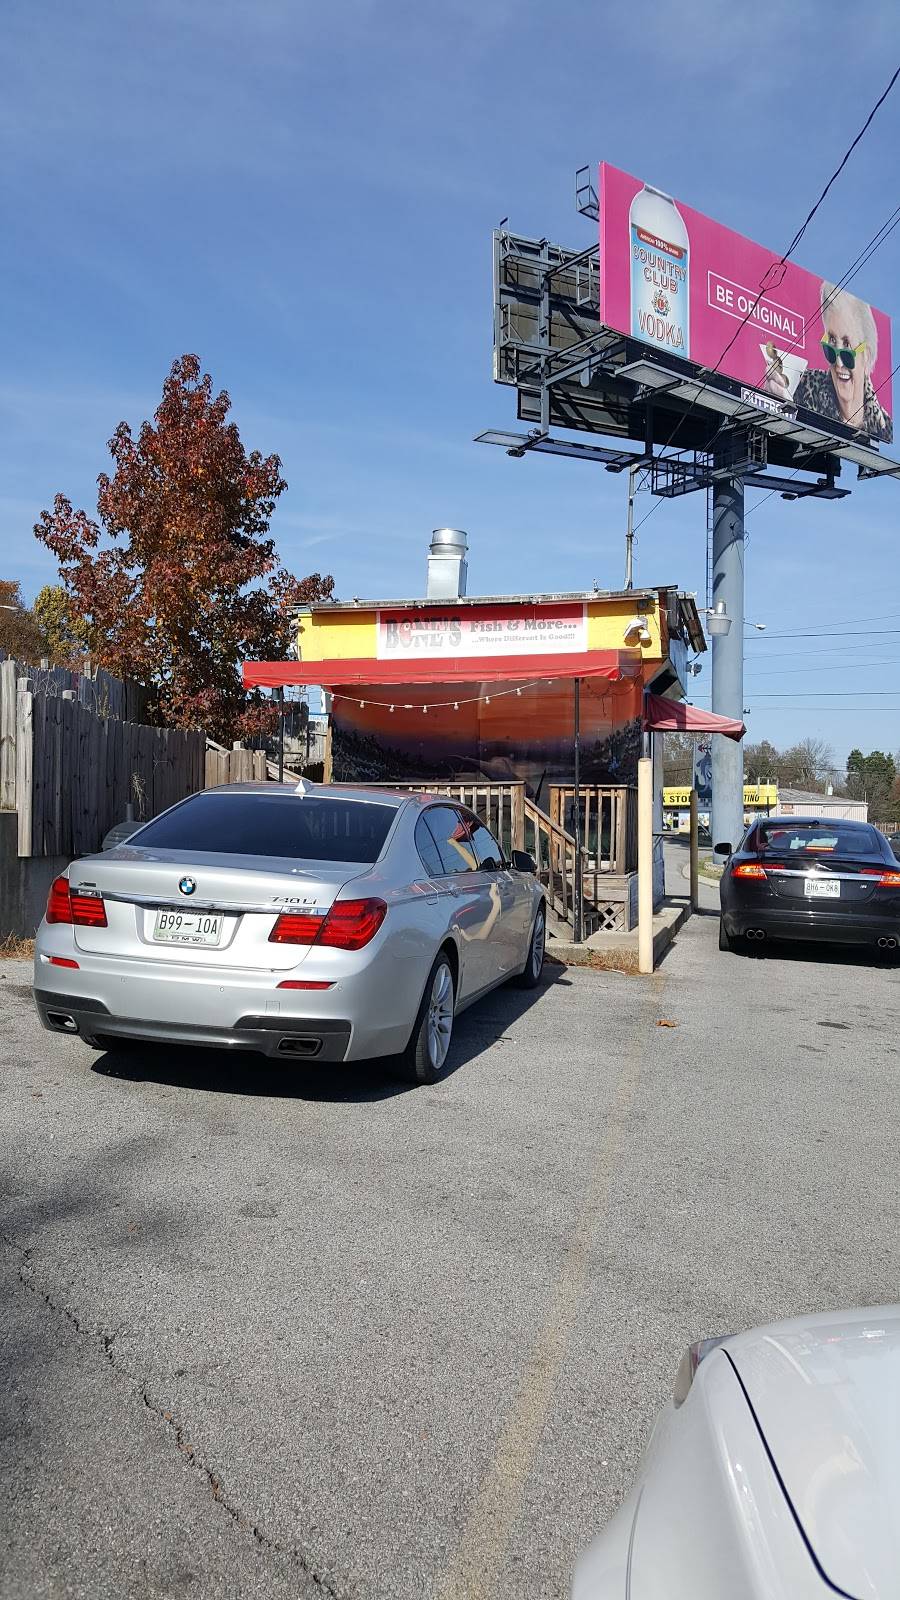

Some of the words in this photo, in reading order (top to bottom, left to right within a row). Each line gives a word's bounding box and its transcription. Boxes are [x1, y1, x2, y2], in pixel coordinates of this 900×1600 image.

[632, 244, 687, 282] COUNTRY
[643, 266, 678, 294] CLUB
[716, 284, 734, 308] BE
[737, 295, 798, 338] ORIGINAL
[638, 309, 685, 350] VODKA
[385, 616, 462, 648] BONE'S
[470, 619, 503, 633] Fish
[507, 618, 520, 631] &
[523, 618, 578, 631] More...
[504, 634, 538, 642] Different
[669, 795, 691, 803] STO
[159, 914, 218, 935] B99-10A
